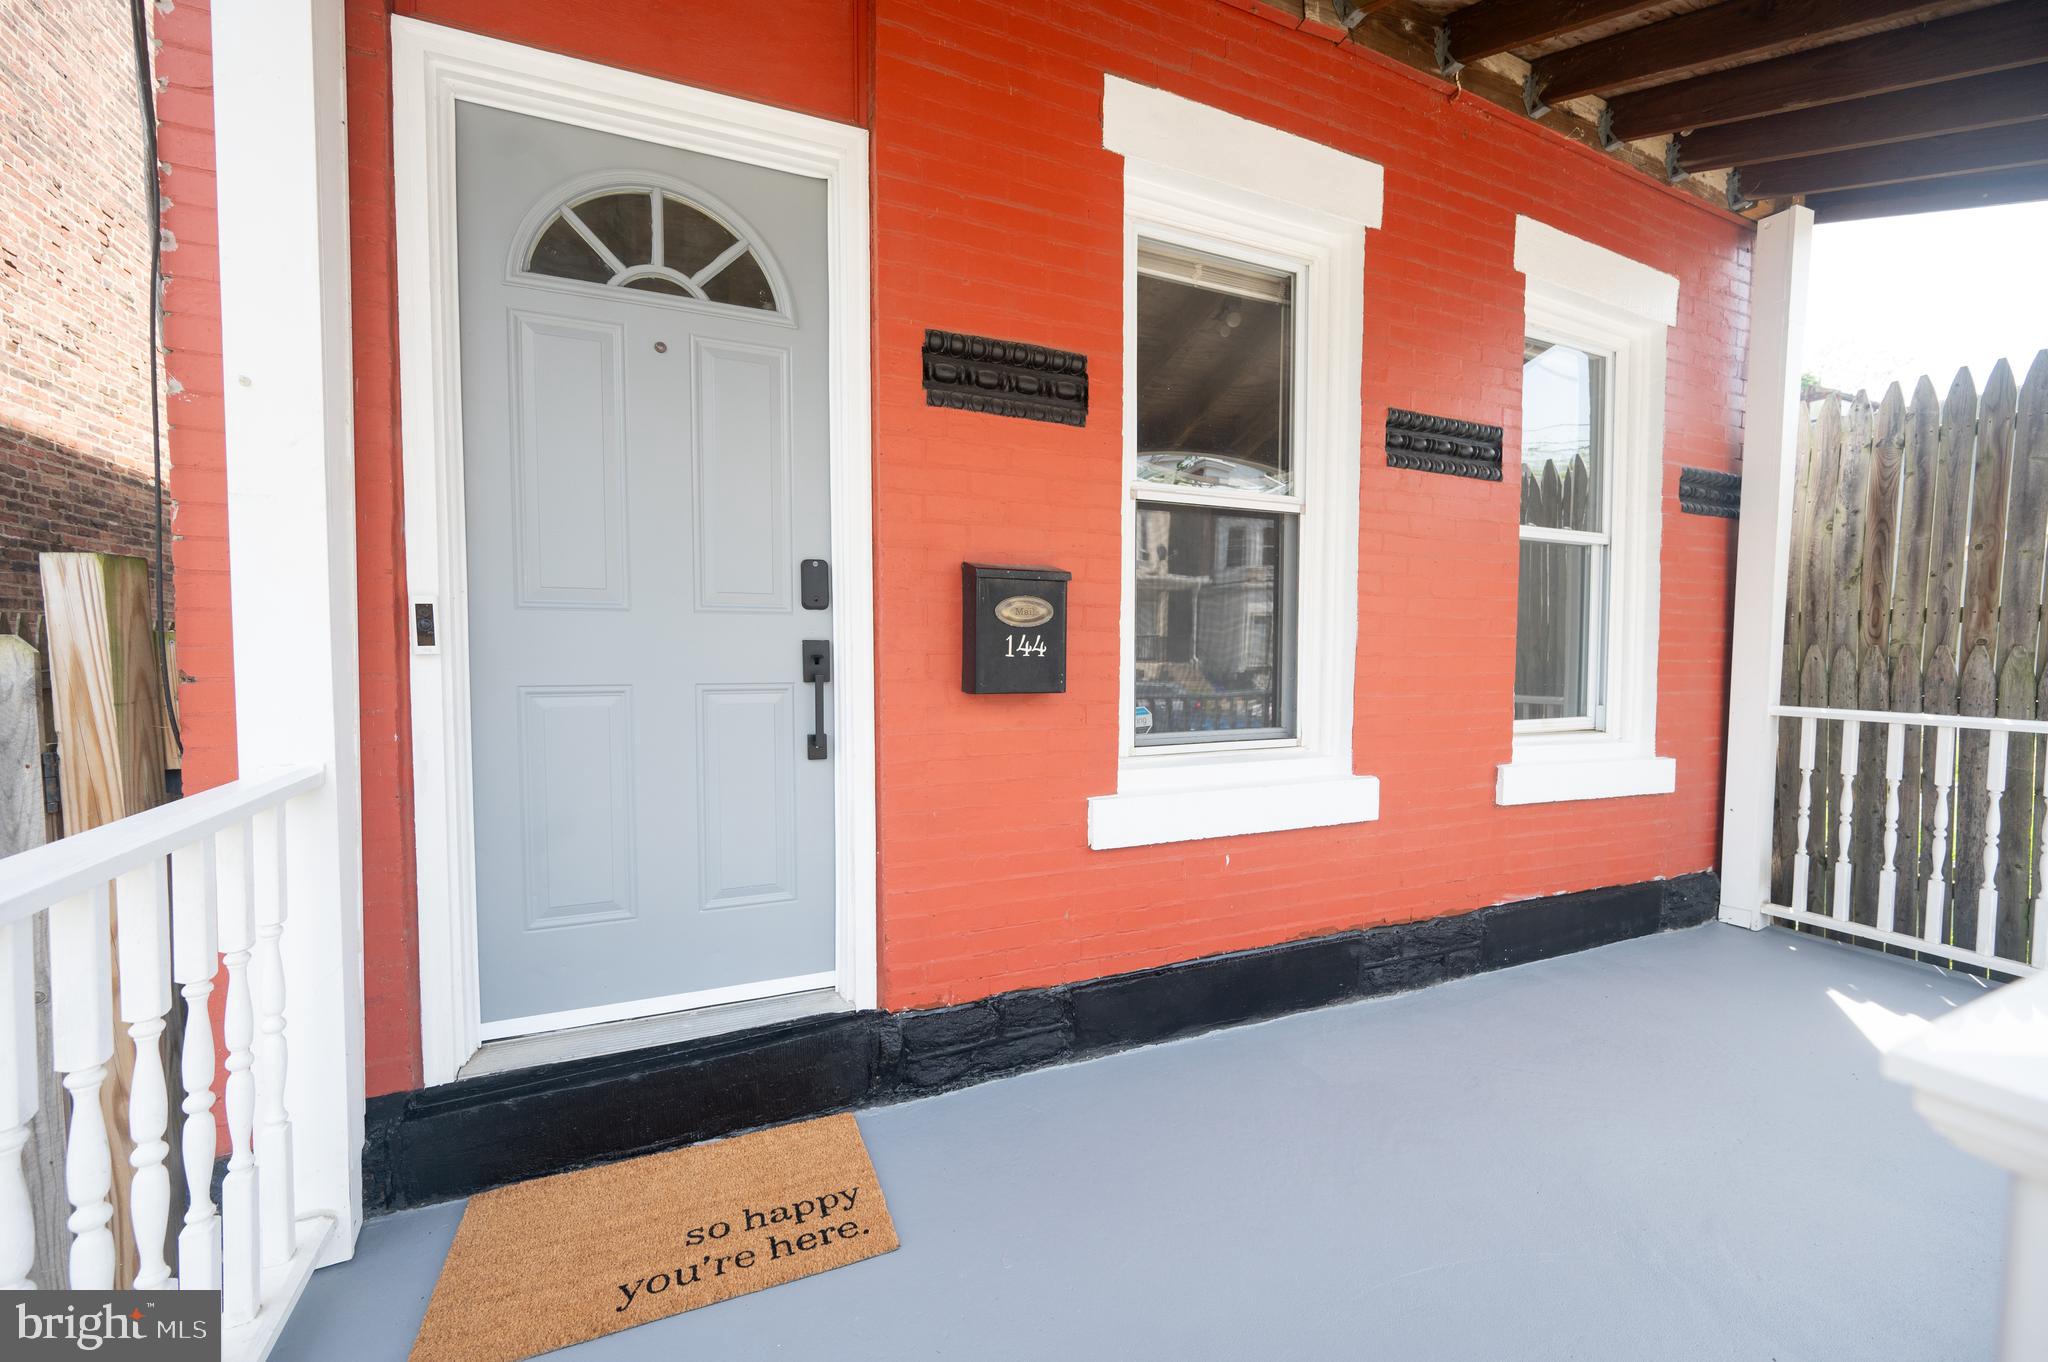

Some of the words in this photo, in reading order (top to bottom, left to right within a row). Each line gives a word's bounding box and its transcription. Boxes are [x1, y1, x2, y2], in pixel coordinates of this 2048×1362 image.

[1005, 634, 1047, 658] 144
[685, 1220, 731, 1246] so
[743, 1186, 860, 1232] happy
[615, 1249, 756, 1313] you're
[768, 1220, 870, 1260] here.
